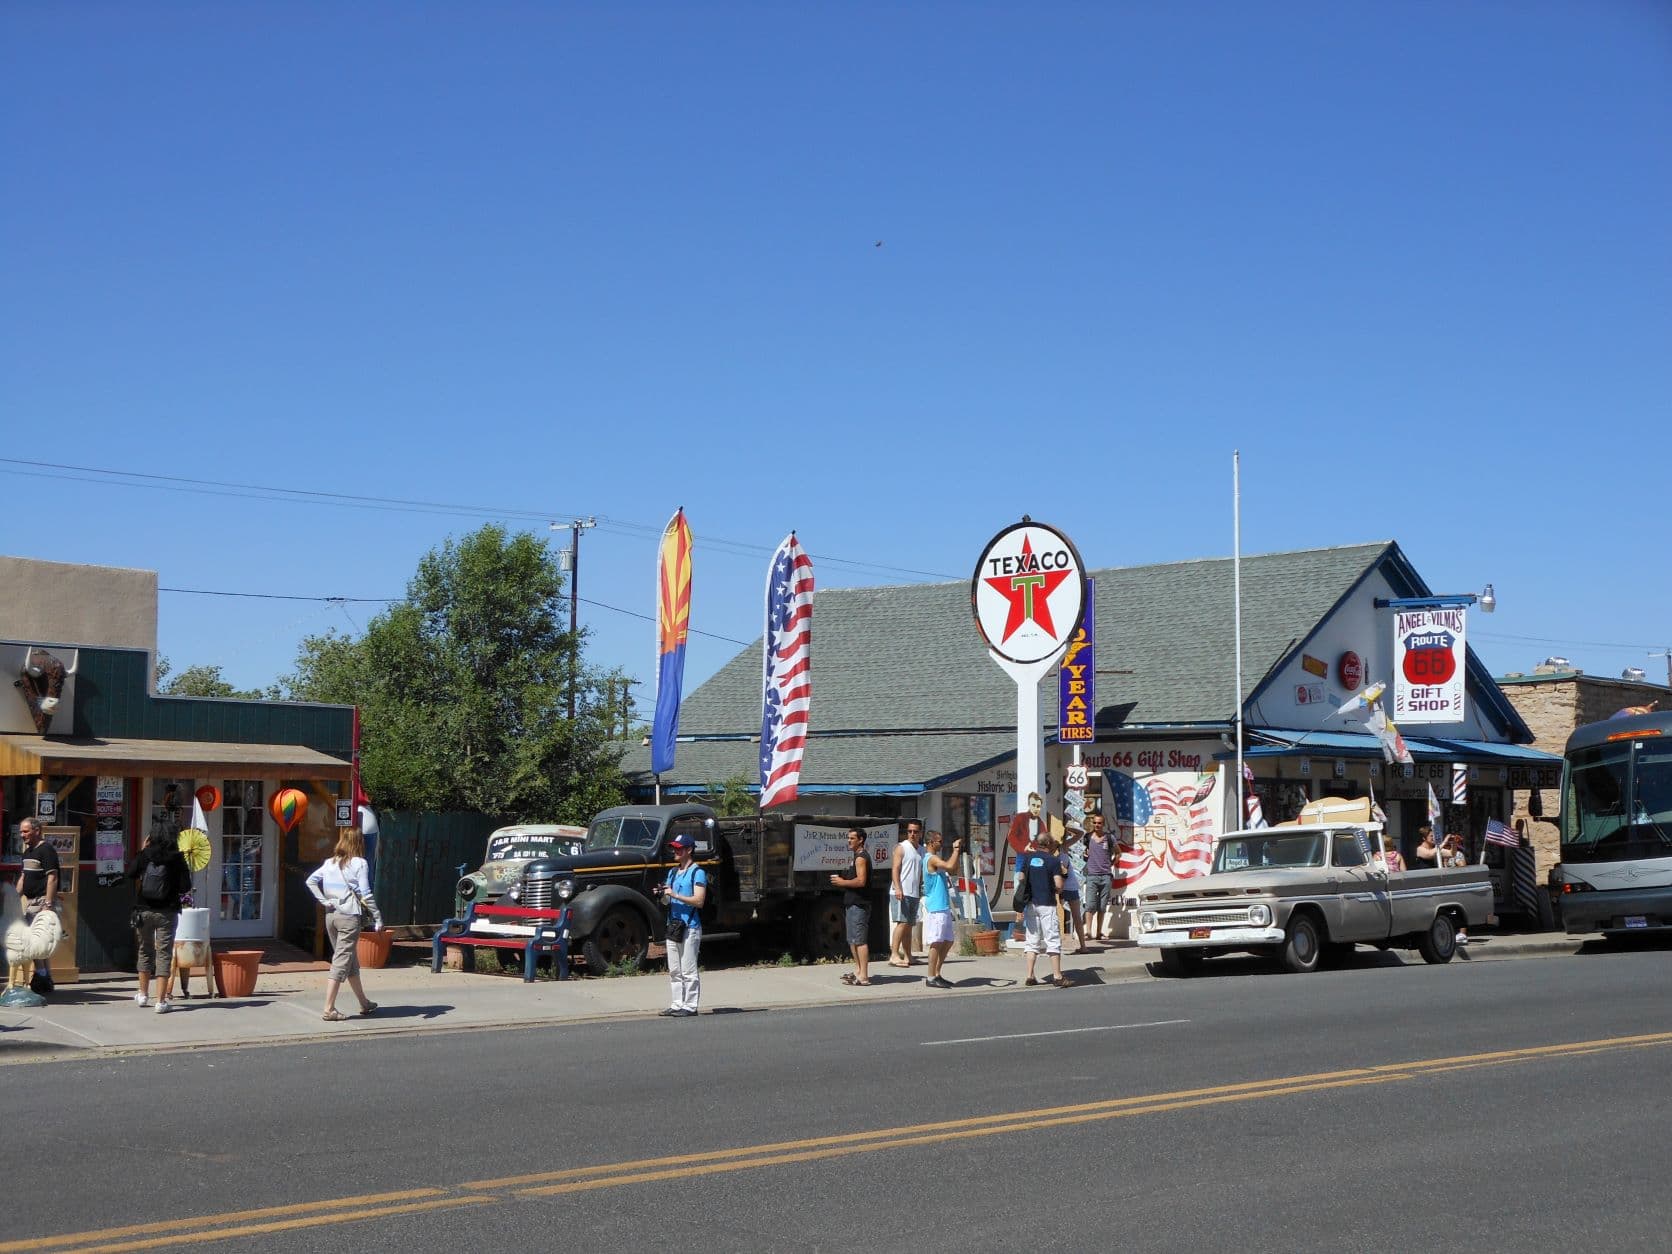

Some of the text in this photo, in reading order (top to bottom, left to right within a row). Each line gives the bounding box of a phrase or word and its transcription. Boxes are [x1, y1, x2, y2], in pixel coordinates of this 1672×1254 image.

[989, 550, 1069, 576] TEXACO
[1011, 574, 1046, 620] T
[1398, 613, 1425, 638] ANGEL
[1431, 611, 1463, 634] VILMAS
[1410, 635, 1448, 650] ROUTE
[1414, 651, 1446, 676] 66
[1411, 688, 1443, 699] GIFT
[1408, 700, 1450, 711] SHOP
[1061, 727, 1093, 739] TIRES
[1112, 751, 1133, 768] 66
[1138, 750, 1165, 773] Gift
[1168, 749, 1201, 772] Shop
[1068, 770, 1085, 784] 66
[1391, 764, 1444, 778] ROTE 66
[1511, 767, 1558, 786] BABE
[493, 836, 555, 847] J&R MINI MART
